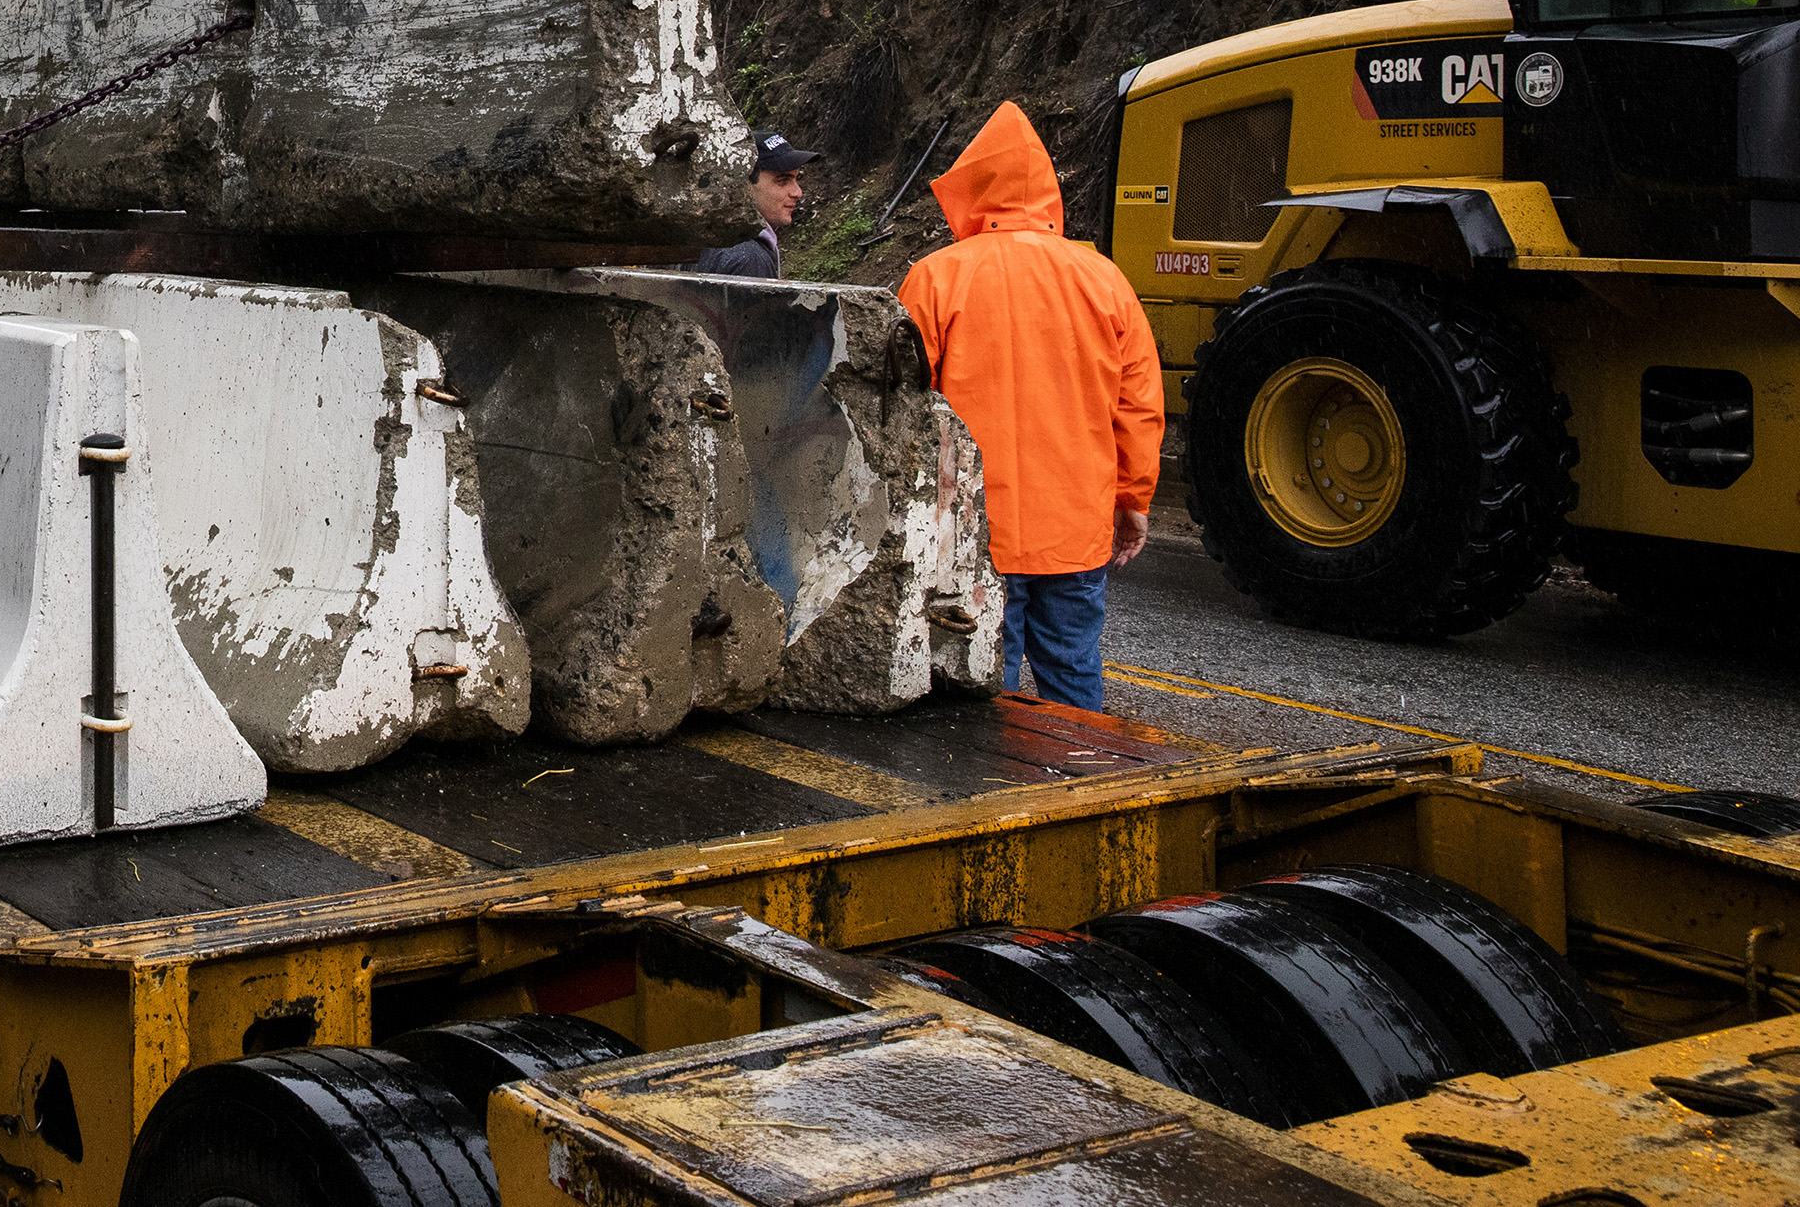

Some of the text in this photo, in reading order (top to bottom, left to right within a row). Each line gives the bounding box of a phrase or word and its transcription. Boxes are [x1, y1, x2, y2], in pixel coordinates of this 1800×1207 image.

[1369, 57, 1423, 83] 938K
[1441, 53, 1504, 104] CAT
[1379, 122, 1477, 138] STREET SERVICES
[1123, 190, 1167, 199] QUINN CAT
[1155, 253, 1209, 274] XU4P93
